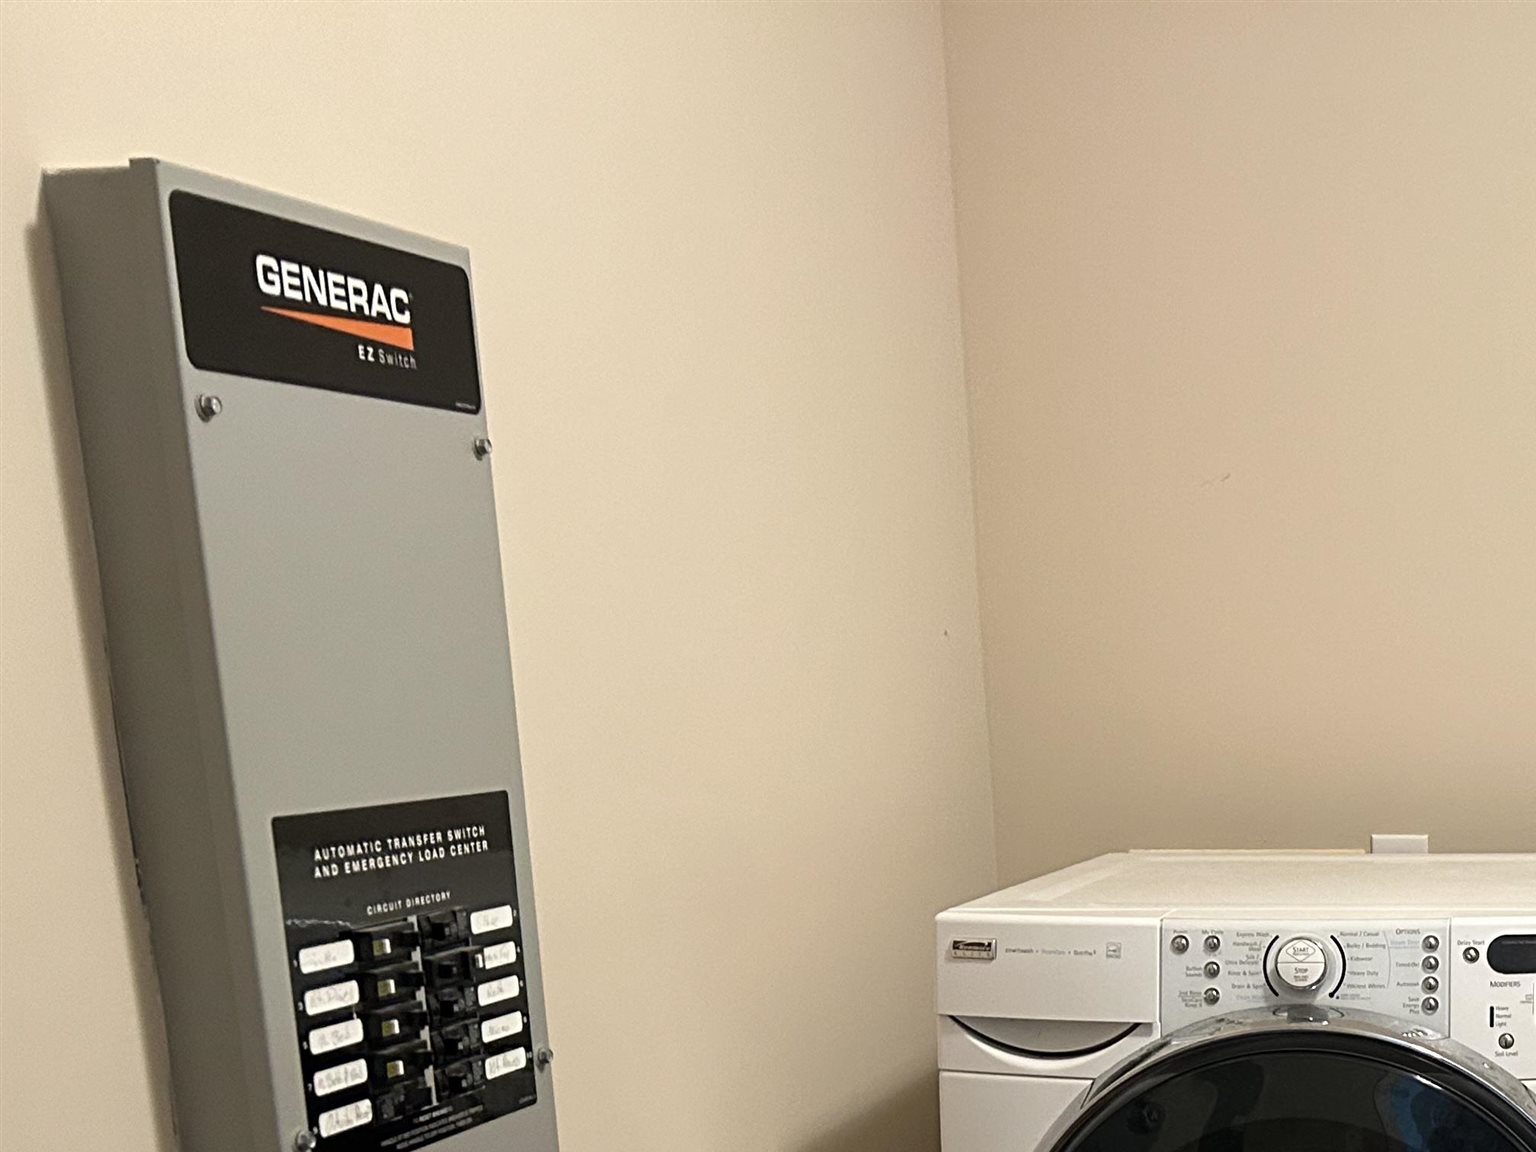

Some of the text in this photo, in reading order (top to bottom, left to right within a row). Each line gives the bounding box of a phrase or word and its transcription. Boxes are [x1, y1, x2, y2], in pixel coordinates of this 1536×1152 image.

[255, 254, 411, 324] GENERAC
[357, 344, 417, 369] EZ Switch
[314, 825, 485, 861] AUTOMATIC TRANSFER SWITCH
[314, 840, 488, 878] AND EMERGENCY LOAD CENTER
[366, 891, 451, 915] CIRCUIT DIRECTORY
